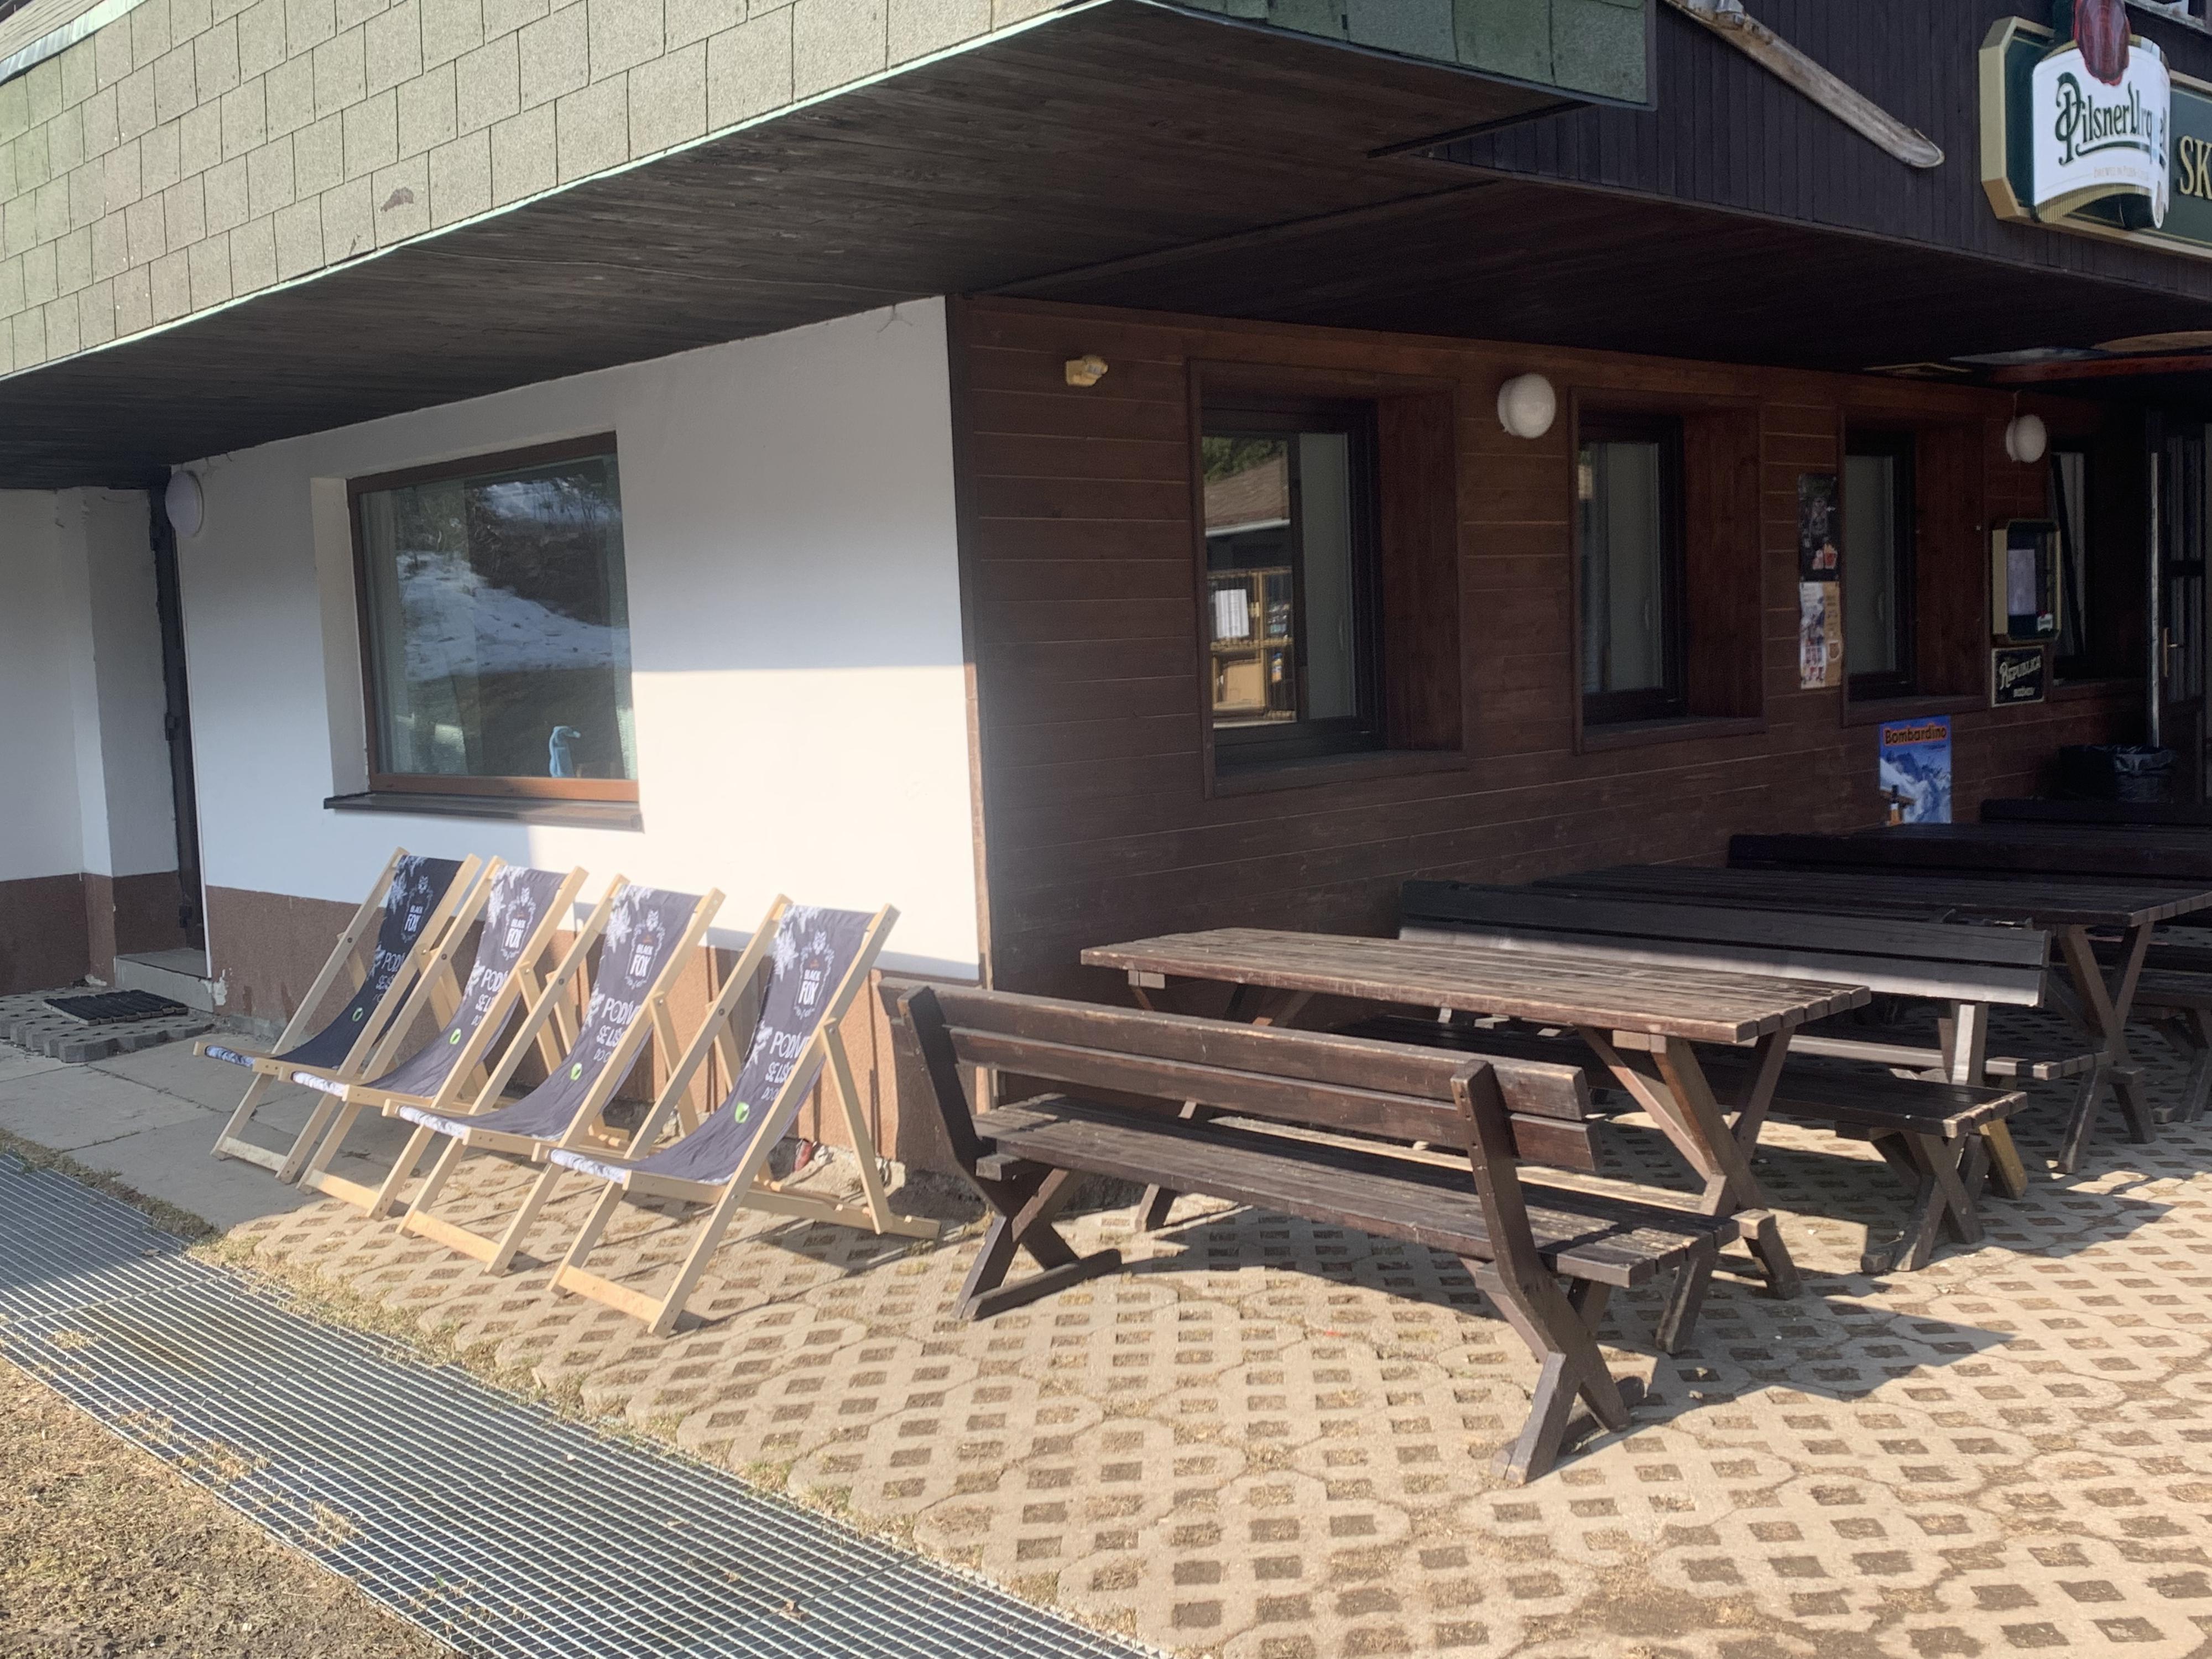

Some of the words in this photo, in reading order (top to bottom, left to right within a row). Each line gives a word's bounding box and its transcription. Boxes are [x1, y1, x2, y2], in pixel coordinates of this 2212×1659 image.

[2055, 72, 2129, 166] Pilsner
[1884, 724, 1947, 745] Bombardino
[404, 913, 421, 932] FOX
[505, 927, 524, 948] FOX
[630, 954, 651, 977] FOX
[798, 980, 819, 1005] FOX
